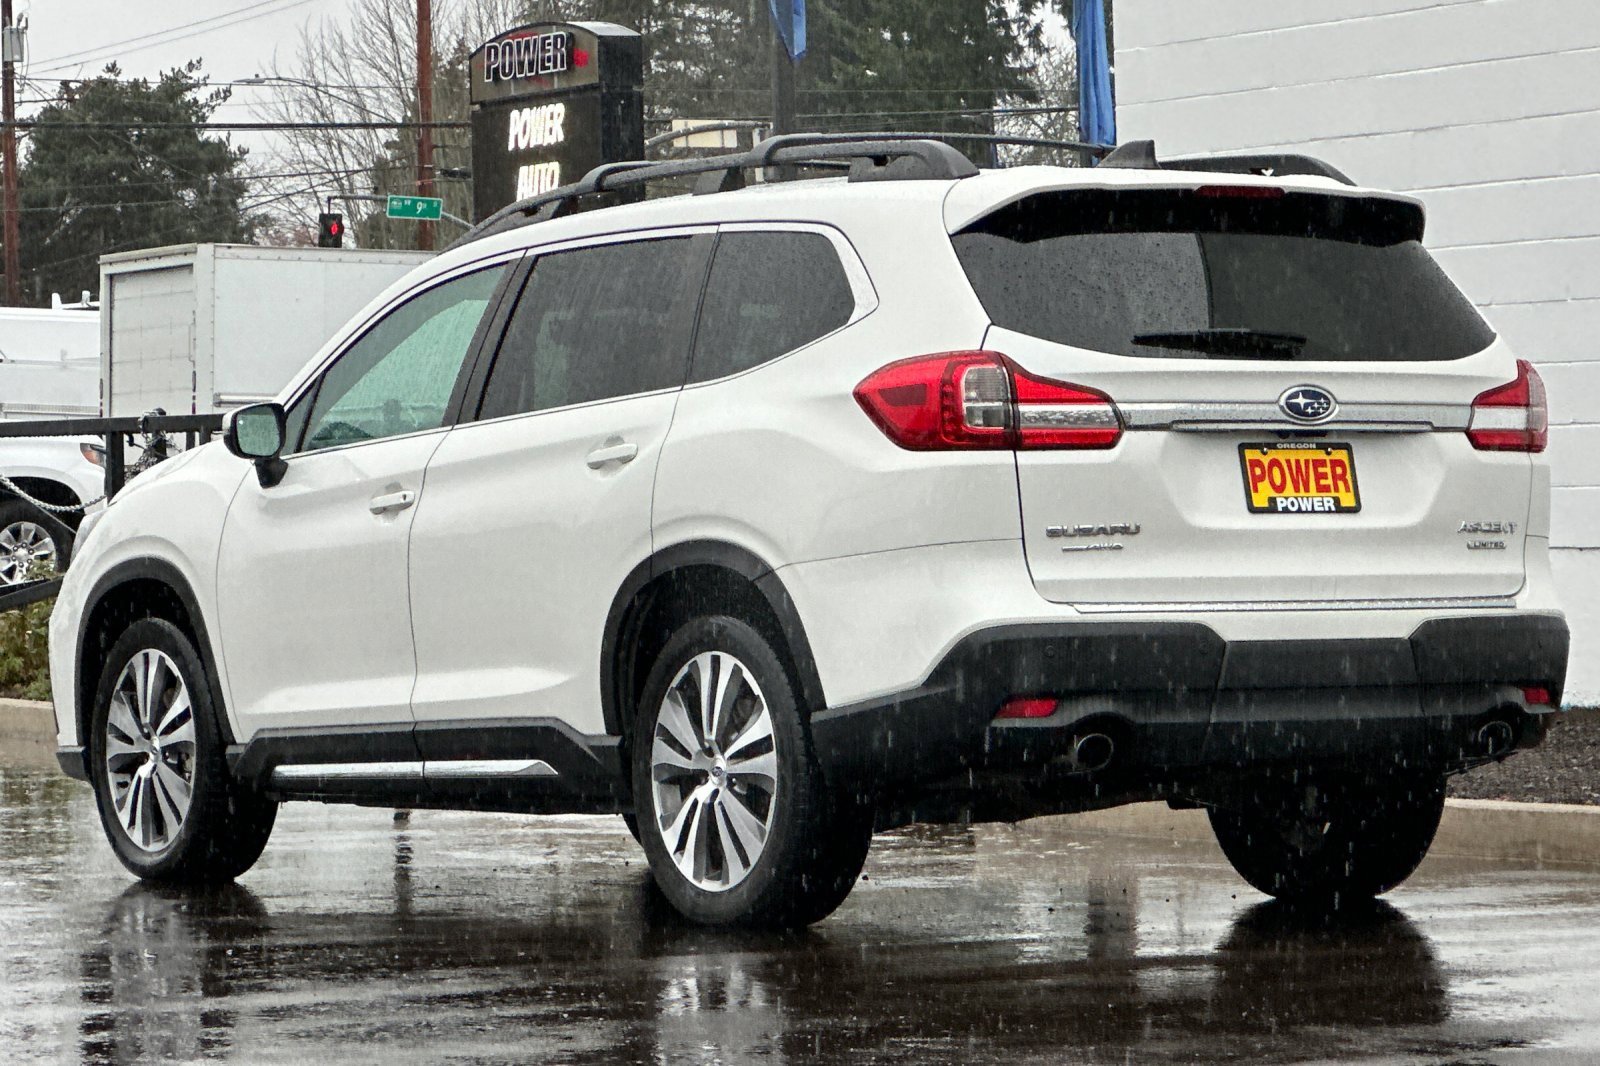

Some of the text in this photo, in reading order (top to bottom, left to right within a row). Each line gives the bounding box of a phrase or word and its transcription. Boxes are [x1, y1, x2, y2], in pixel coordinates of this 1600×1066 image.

[484, 31, 568, 82] POWER
[508, 103, 565, 151] POWER
[516, 162, 559, 201] AUTO
[1247, 457, 1351, 494] POWER
[1275, 496, 1336, 511] POWER
[1045, 523, 1141, 537] SUBARU
